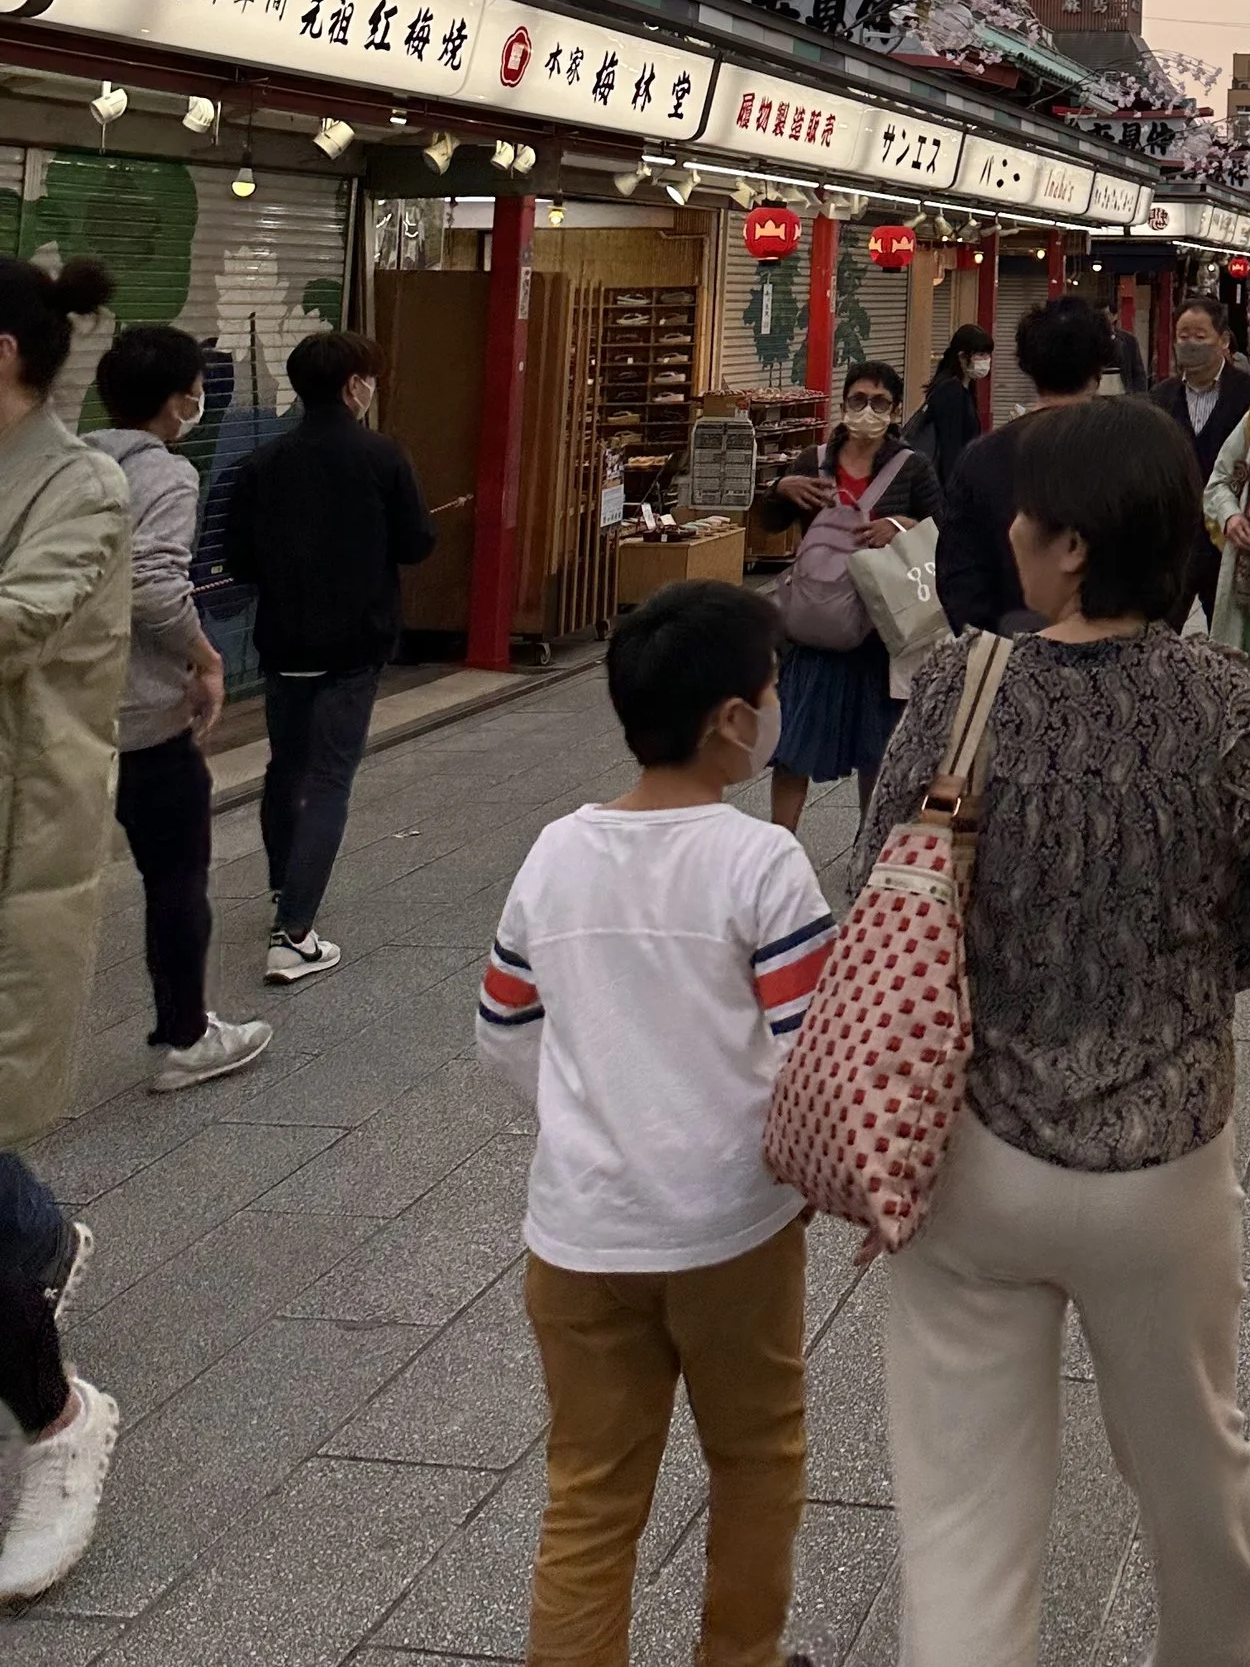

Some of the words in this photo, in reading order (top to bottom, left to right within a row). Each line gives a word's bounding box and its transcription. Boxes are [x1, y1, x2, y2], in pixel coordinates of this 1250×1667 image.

[592, 50, 692, 120] 梅林堂
[737, 93, 835, 148] 履物製造販売
[883, 124, 942, 175] サンエス
